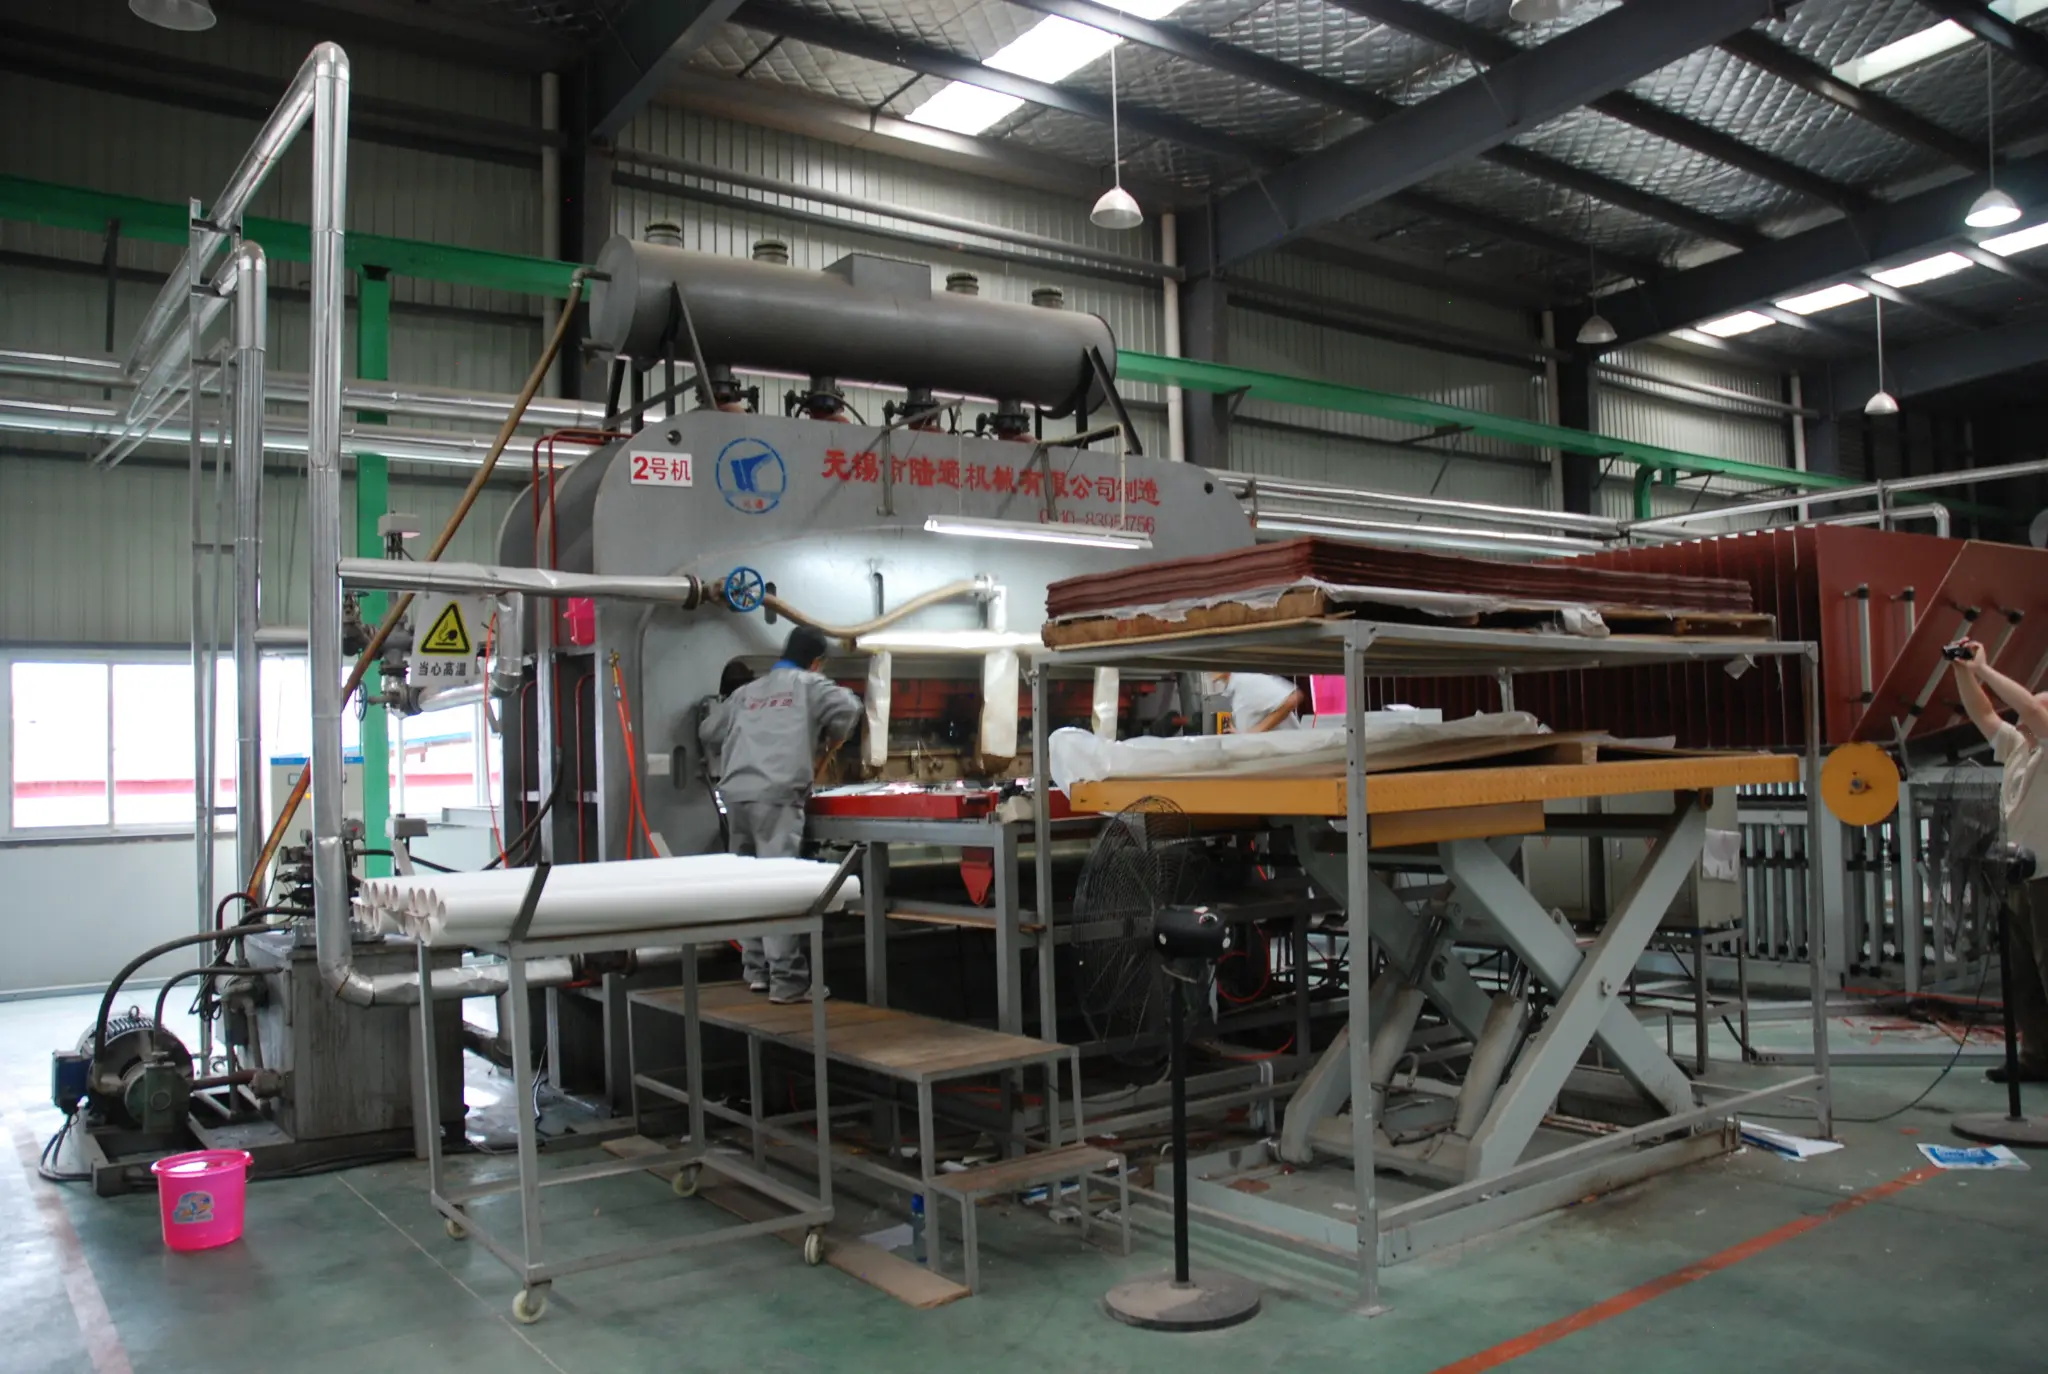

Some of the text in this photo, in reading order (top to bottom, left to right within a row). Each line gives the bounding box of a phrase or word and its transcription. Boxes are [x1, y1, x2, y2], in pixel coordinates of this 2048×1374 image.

[633, 456, 691, 481] 2号机
[419, 661, 467, 676] 当心高温
